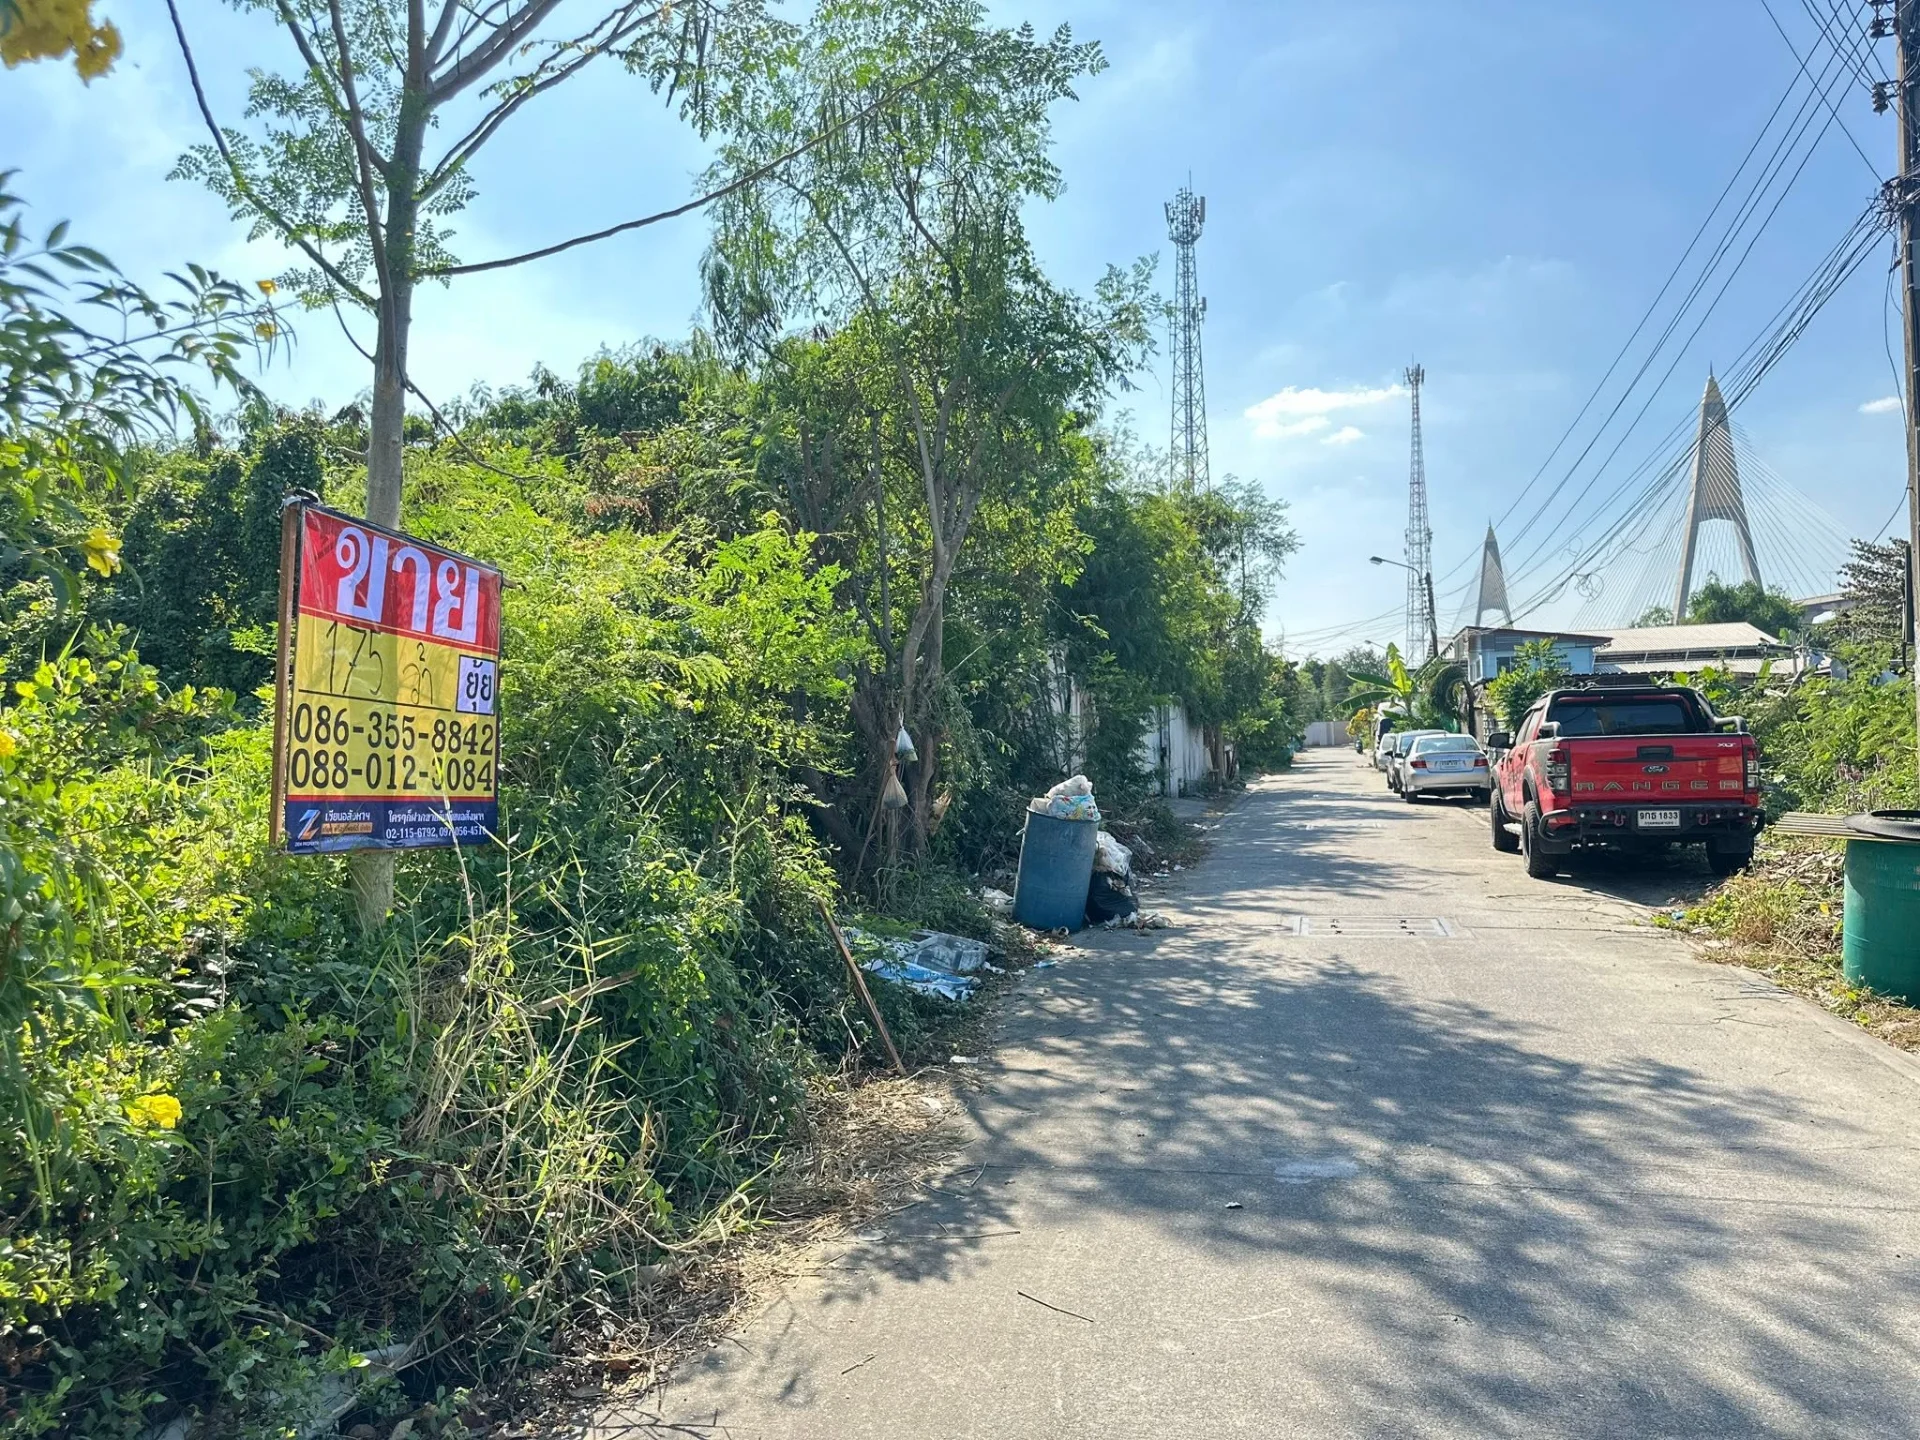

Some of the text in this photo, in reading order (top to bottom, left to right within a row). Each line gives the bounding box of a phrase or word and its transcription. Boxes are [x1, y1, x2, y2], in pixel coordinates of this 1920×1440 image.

[336, 527, 479, 643] ขาย
[326, 620, 384, 695] 175
[465, 659, 493, 712] ยุ้ย
[294, 703, 494, 756] 086-355-8842
[291, 748, 493, 792] 088-012-3084
[1576, 780, 1739, 791] RANGER
[1659, 811, 1678, 820] 1833
